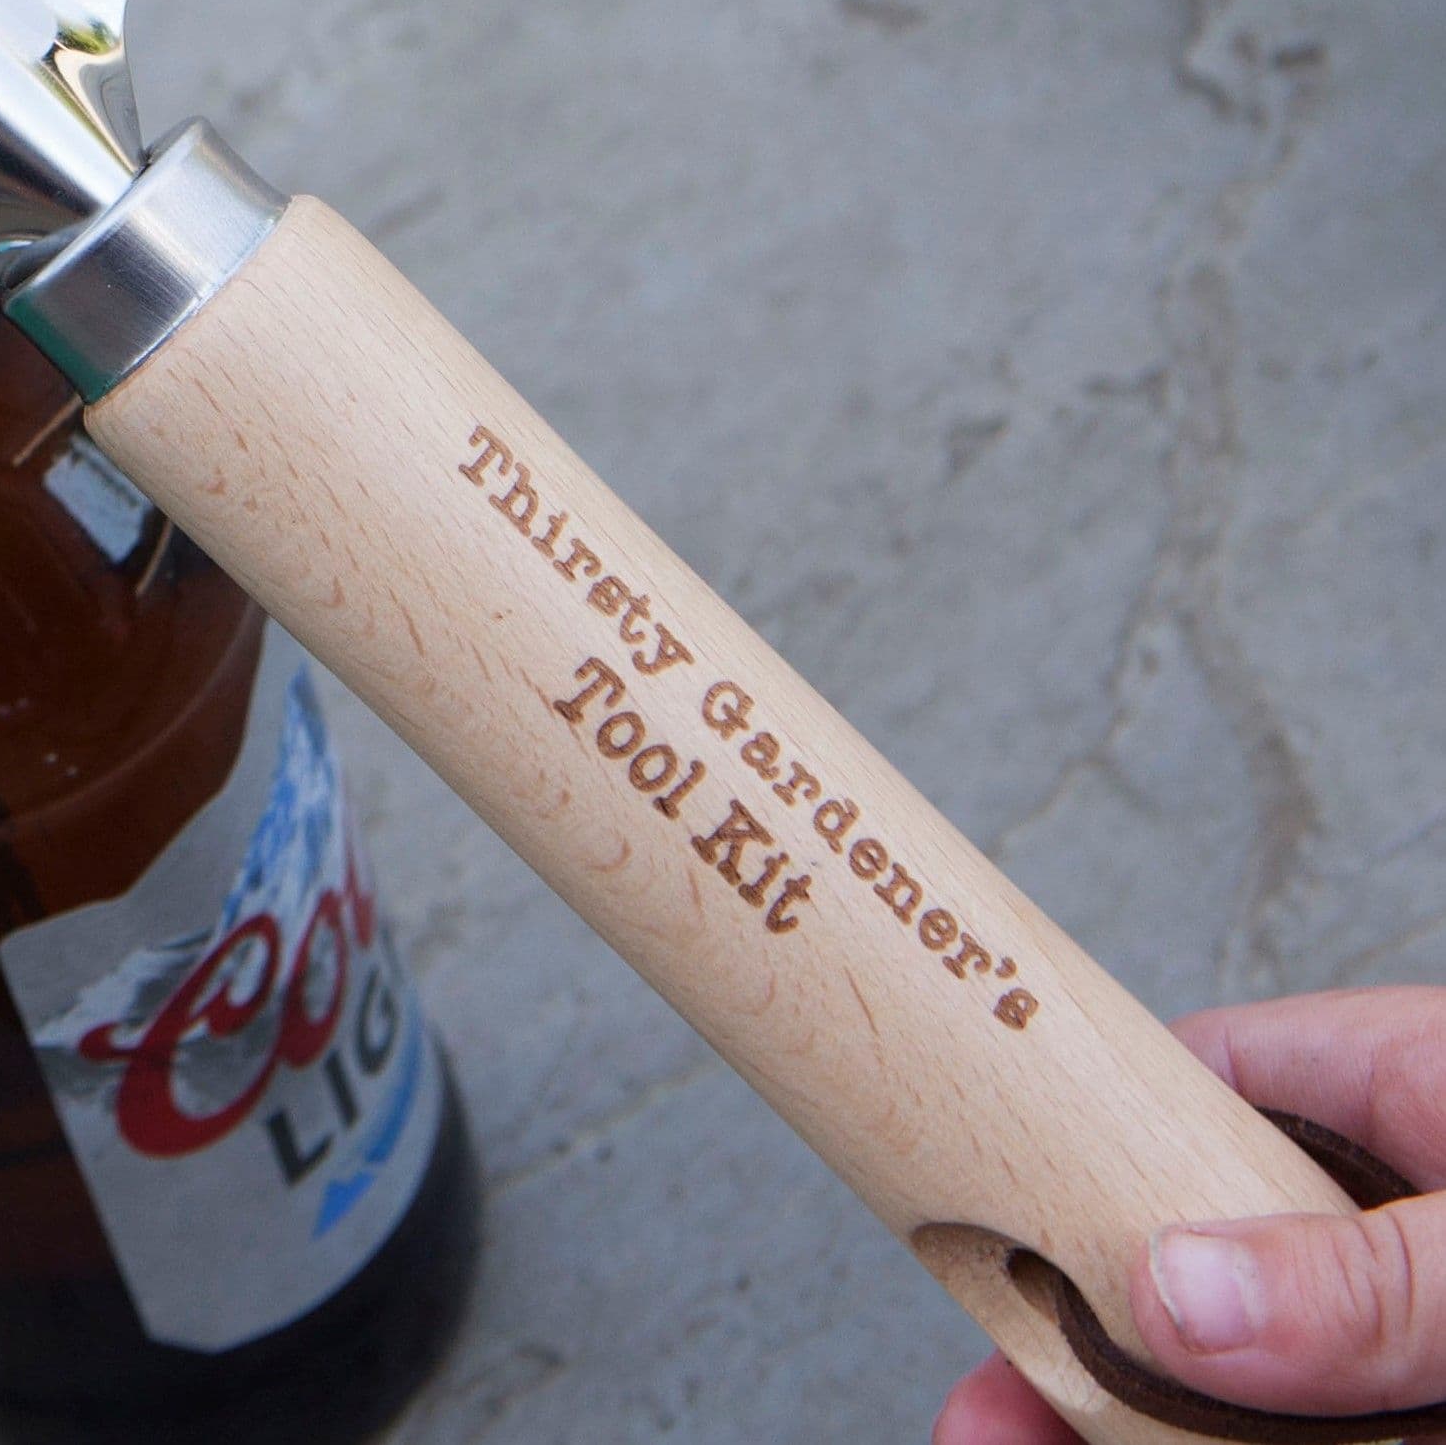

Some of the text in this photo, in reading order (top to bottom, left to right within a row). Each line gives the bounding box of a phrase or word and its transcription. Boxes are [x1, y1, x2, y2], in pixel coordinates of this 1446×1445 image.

[458, 425, 1039, 1030] Thirsty Gardener's
[554, 656, 812, 934] Tool Kit
[264, 949, 404, 1188] LIG
